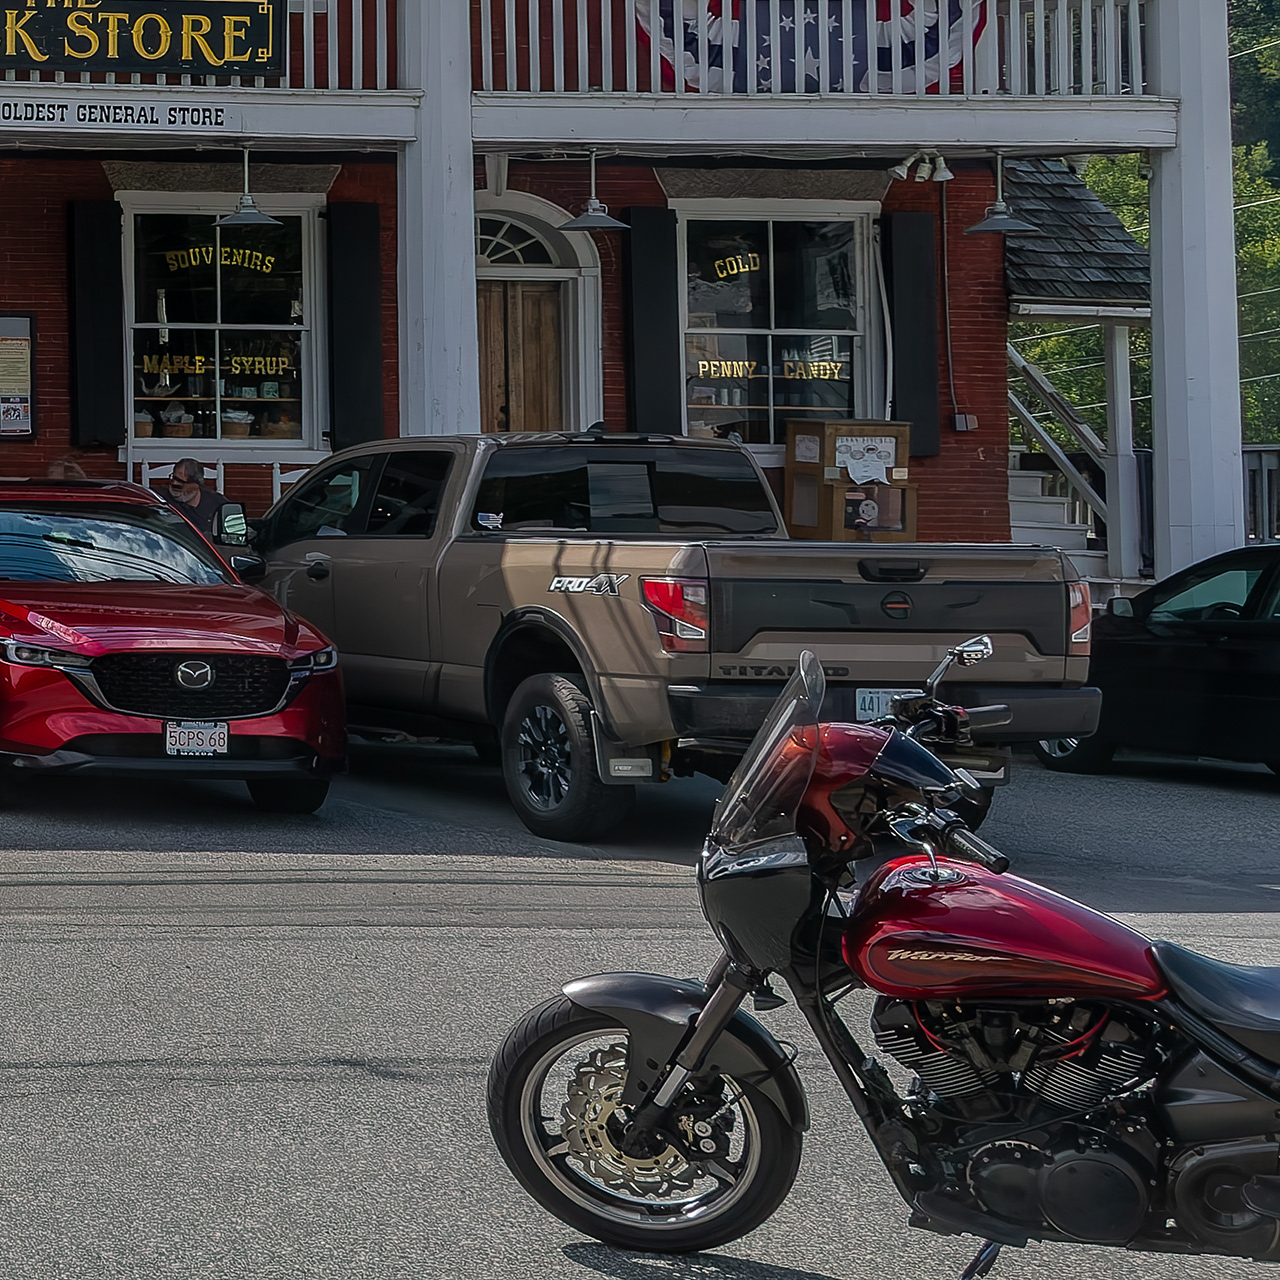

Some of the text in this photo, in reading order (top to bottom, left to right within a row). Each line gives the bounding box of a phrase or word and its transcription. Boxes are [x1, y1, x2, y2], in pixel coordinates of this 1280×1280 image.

[64, 11, 253, 67] STORE
[1, 102, 69, 122] OLDEST
[77, 104, 159, 125] GENERAL
[168, 106, 226, 126] STORE
[165, 246, 276, 273] SOUVENIRS
[714, 253, 760, 278] COLD
[143, 355, 290, 375] MAPLE SYRUP
[698, 361, 843, 380] PENNY CANDY
[169, 730, 226, 747] 5CPS 68
[887, 948, 1014, 962] Warrior
